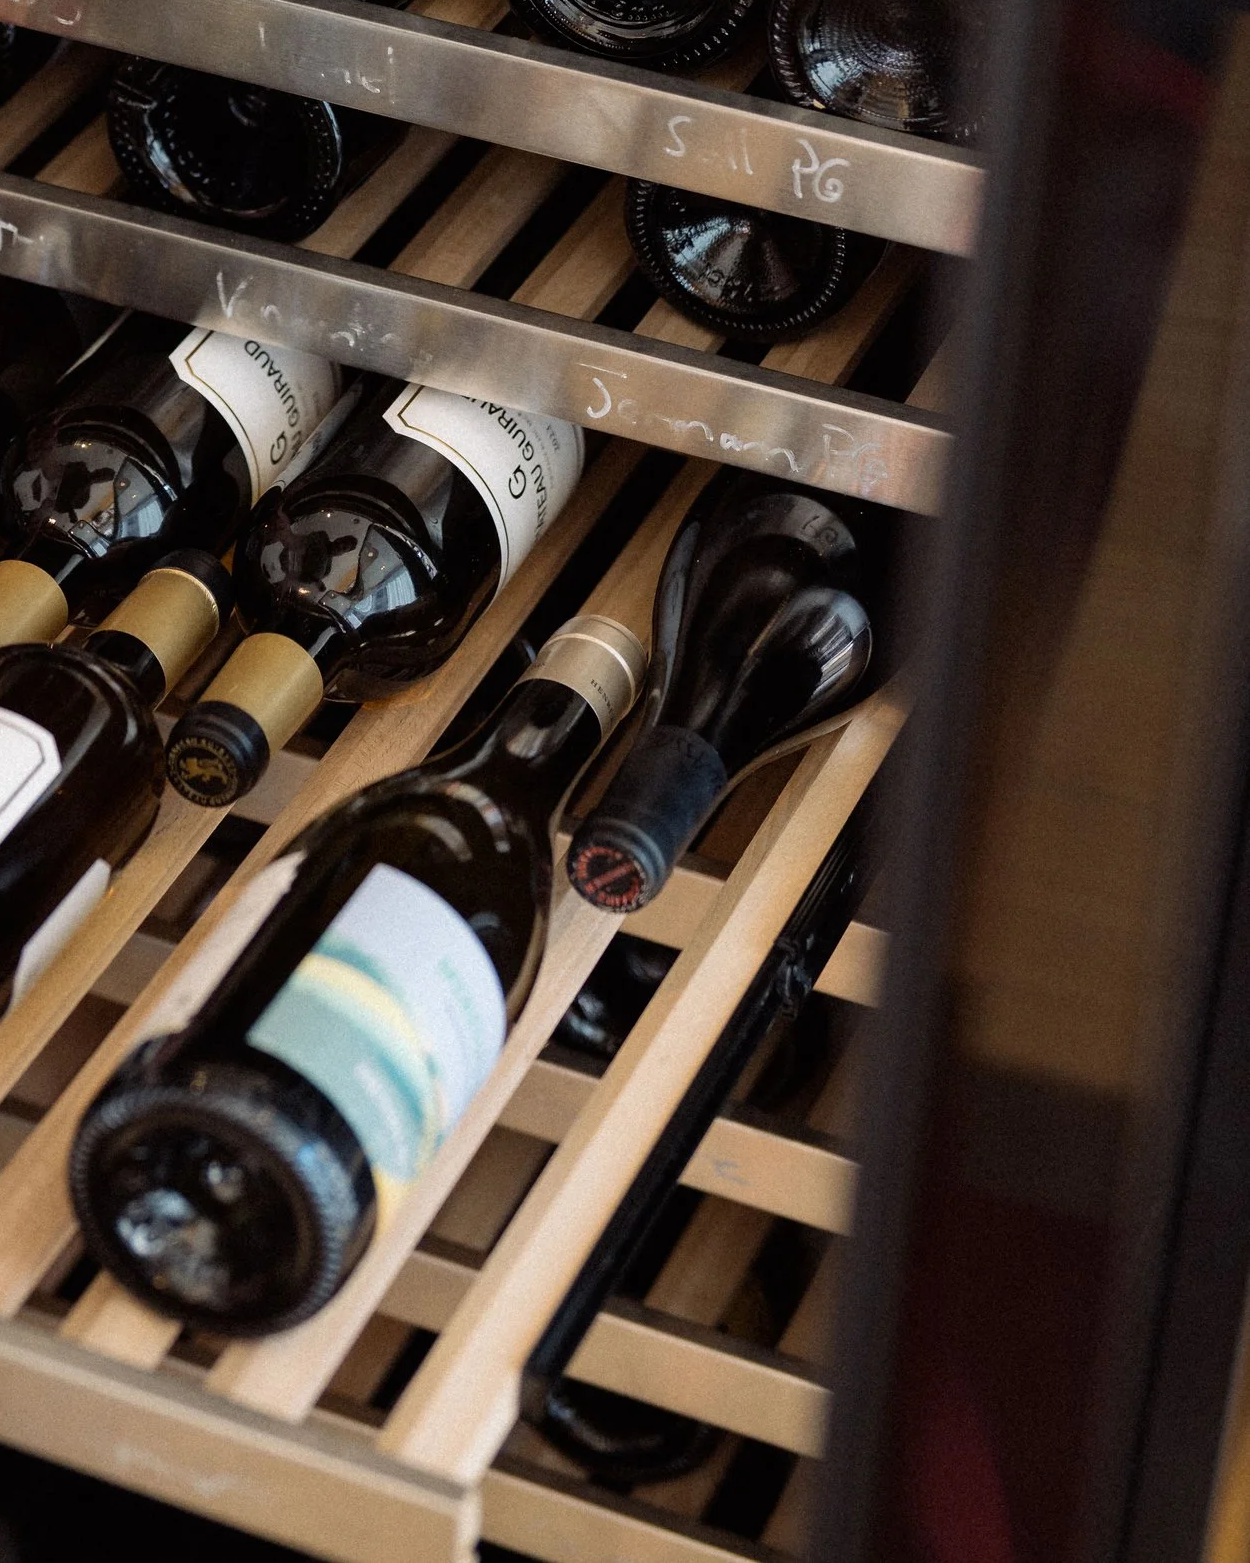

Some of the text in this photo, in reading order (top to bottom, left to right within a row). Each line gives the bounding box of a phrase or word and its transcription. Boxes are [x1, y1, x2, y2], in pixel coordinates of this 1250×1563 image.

[244, 340, 300, 428] GUIRAUD
[269, 430, 289, 466] G
[508, 464, 527, 500] G
